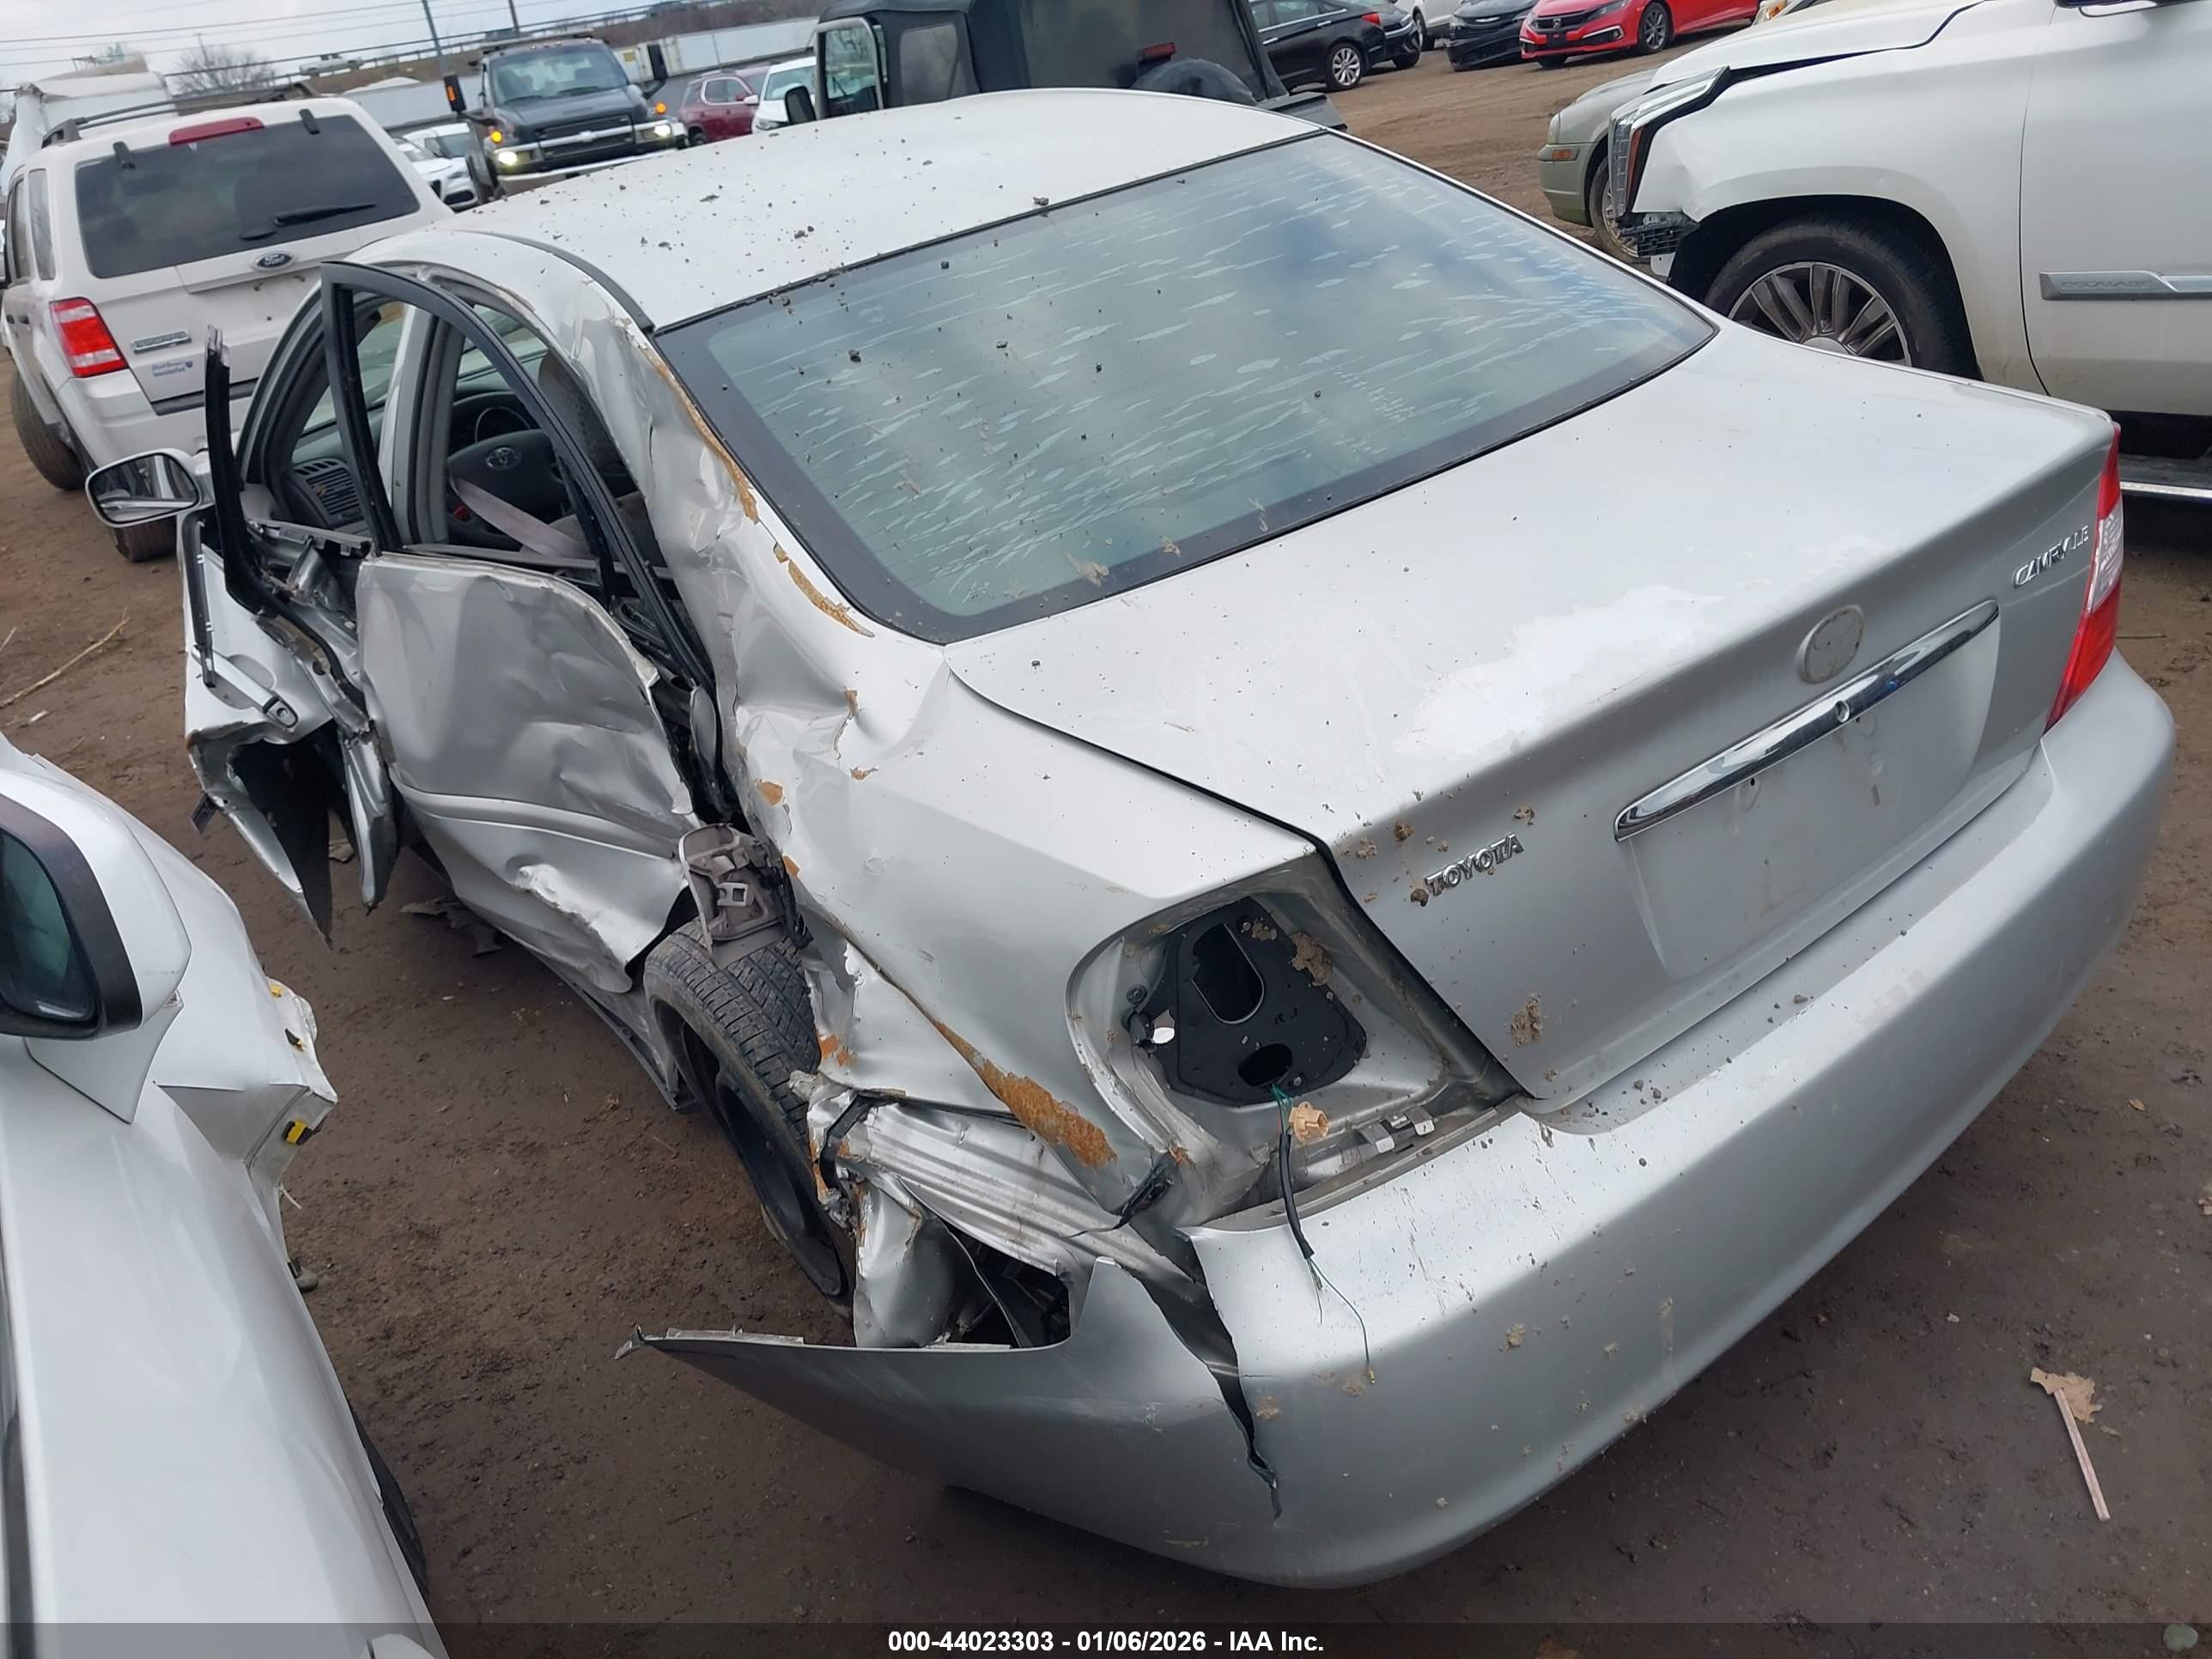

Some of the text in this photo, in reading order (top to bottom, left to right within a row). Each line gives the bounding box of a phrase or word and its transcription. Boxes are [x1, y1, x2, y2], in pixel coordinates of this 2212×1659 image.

[2012, 525, 2089, 587] CAMRY LE
[1425, 833, 1525, 896] TOYOTA
